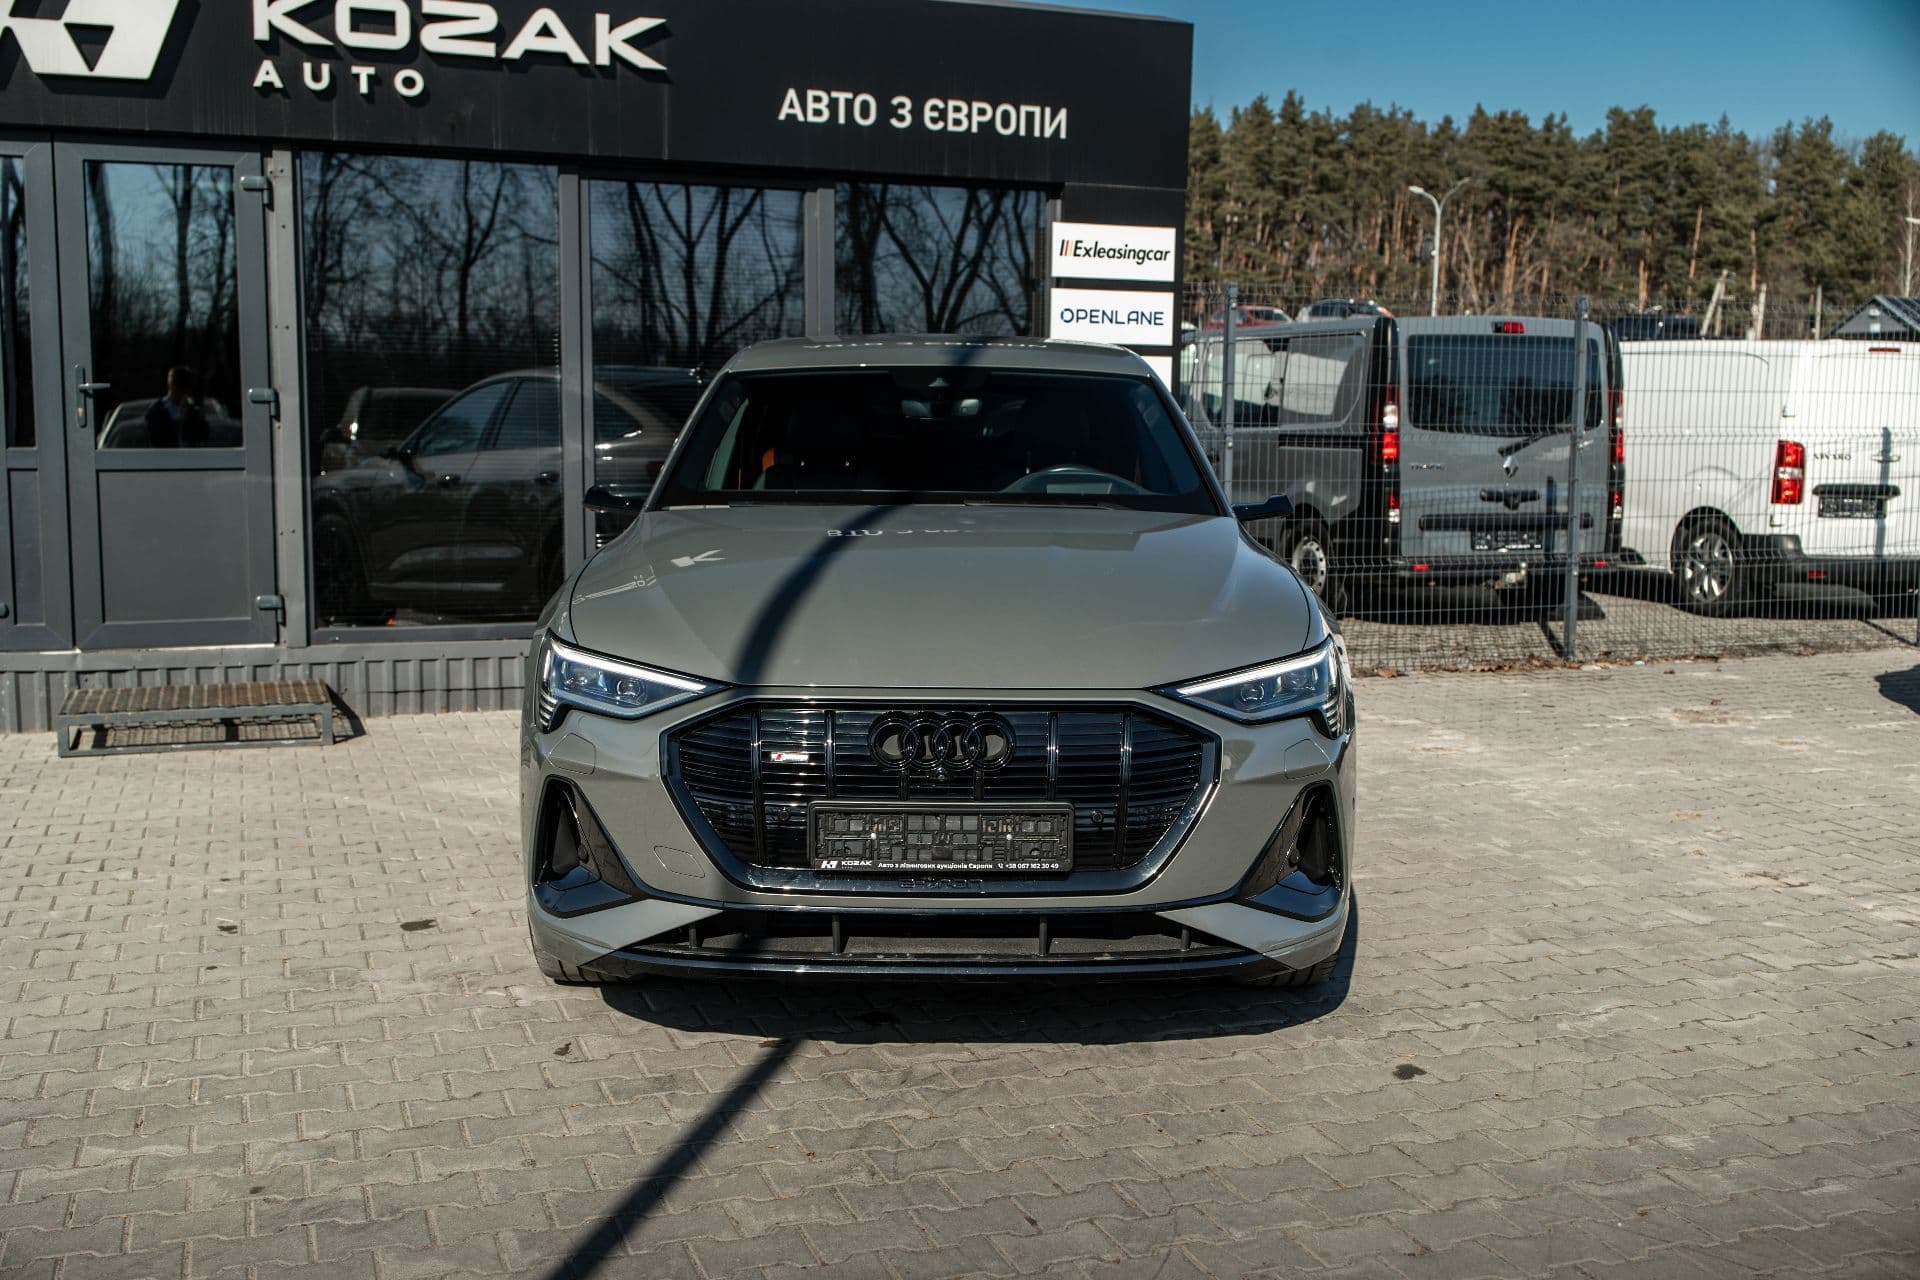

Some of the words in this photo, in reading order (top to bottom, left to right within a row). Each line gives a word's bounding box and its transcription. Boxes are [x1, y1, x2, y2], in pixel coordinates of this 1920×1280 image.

[253, 0, 667, 72] KOZAK
[253, 59, 425, 97] AUTO
[778, 88, 877, 127] АВТО
[889, 96, 913, 129] З
[923, 98, 1068, 140] ЄВРОПИ
[1073, 240, 1170, 265] Exleasingcar
[1060, 308, 1164, 326] OPENLANE
